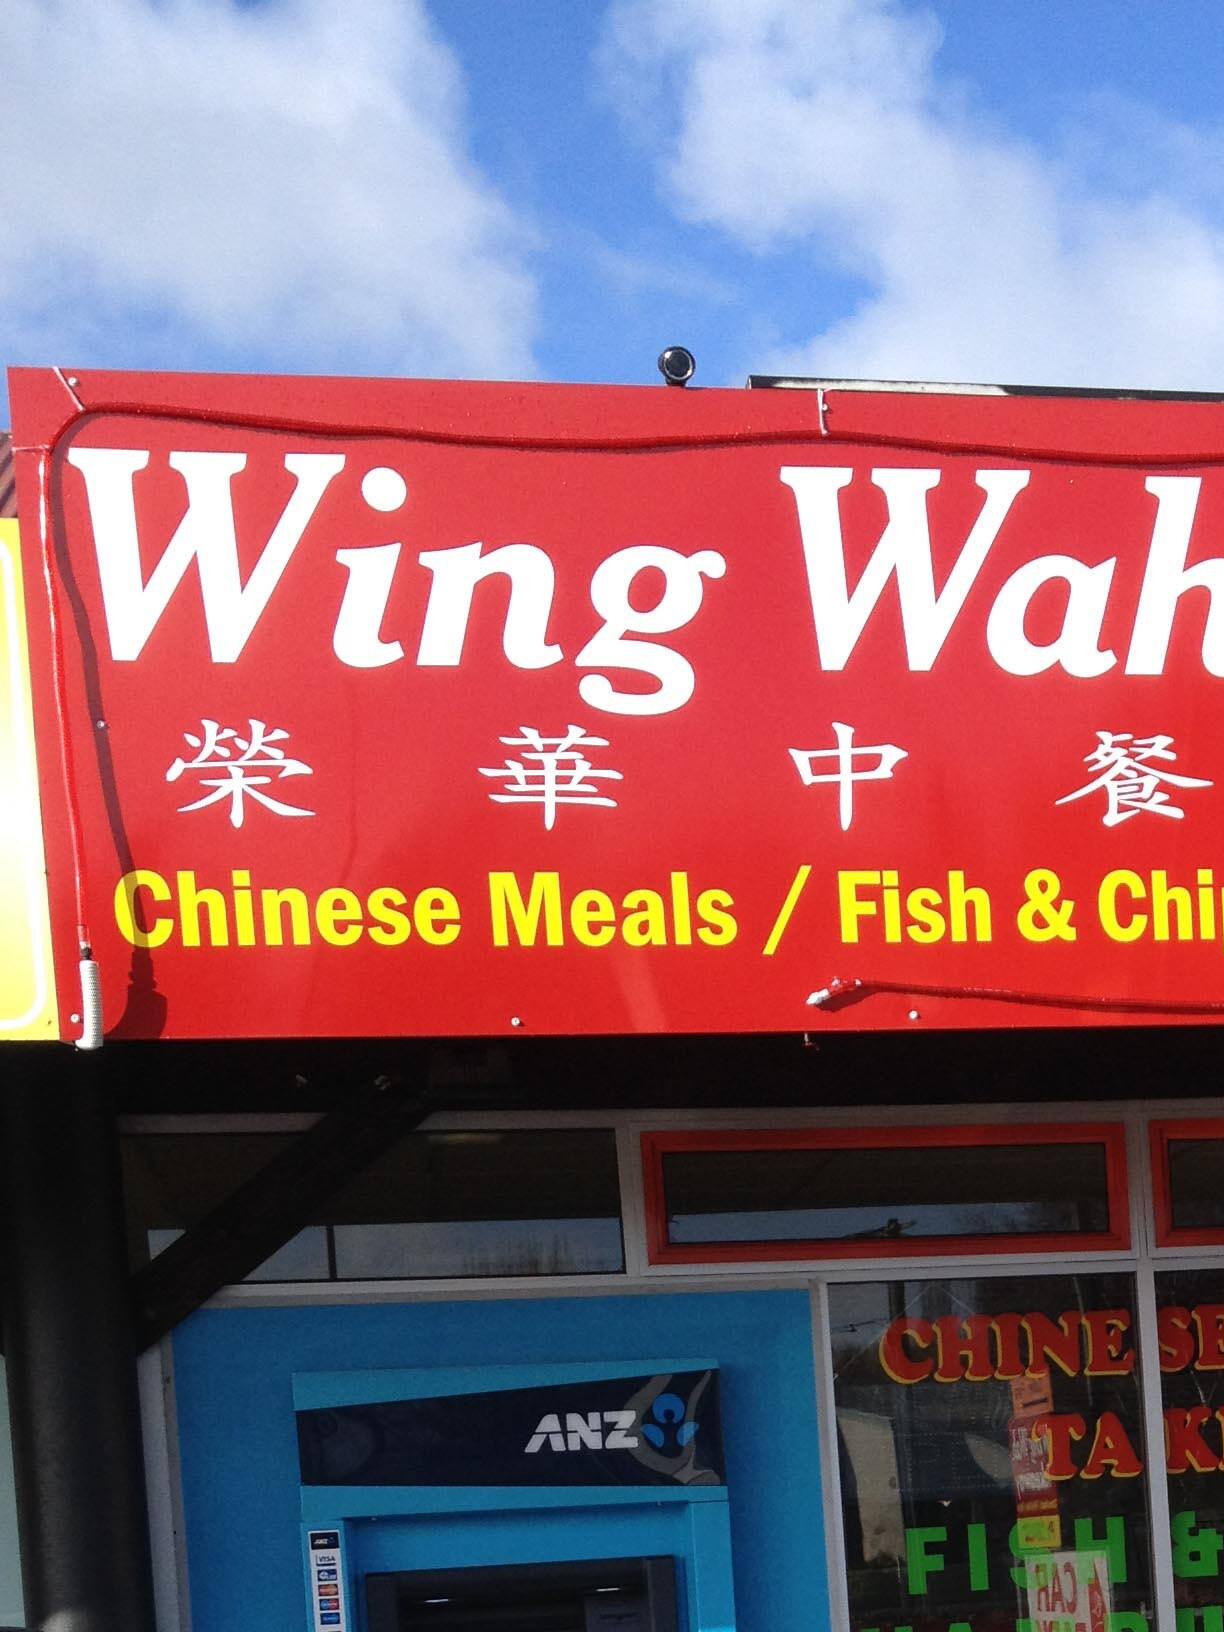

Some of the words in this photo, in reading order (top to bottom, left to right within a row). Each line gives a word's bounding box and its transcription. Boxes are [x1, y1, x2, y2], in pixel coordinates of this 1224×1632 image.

[67, 446, 728, 716] Wing
[114, 869, 461, 949] Chinese
[488, 871, 738, 948] Meals
[761, 864, 813, 956] /
[837, 869, 993, 944] Fish
[1016, 869, 1077, 943] &
[524, 1409, 640, 1453] ANZ
[905, 1516, 1128, 1595] FISH
[1171, 1510, 1224, 1578] &
